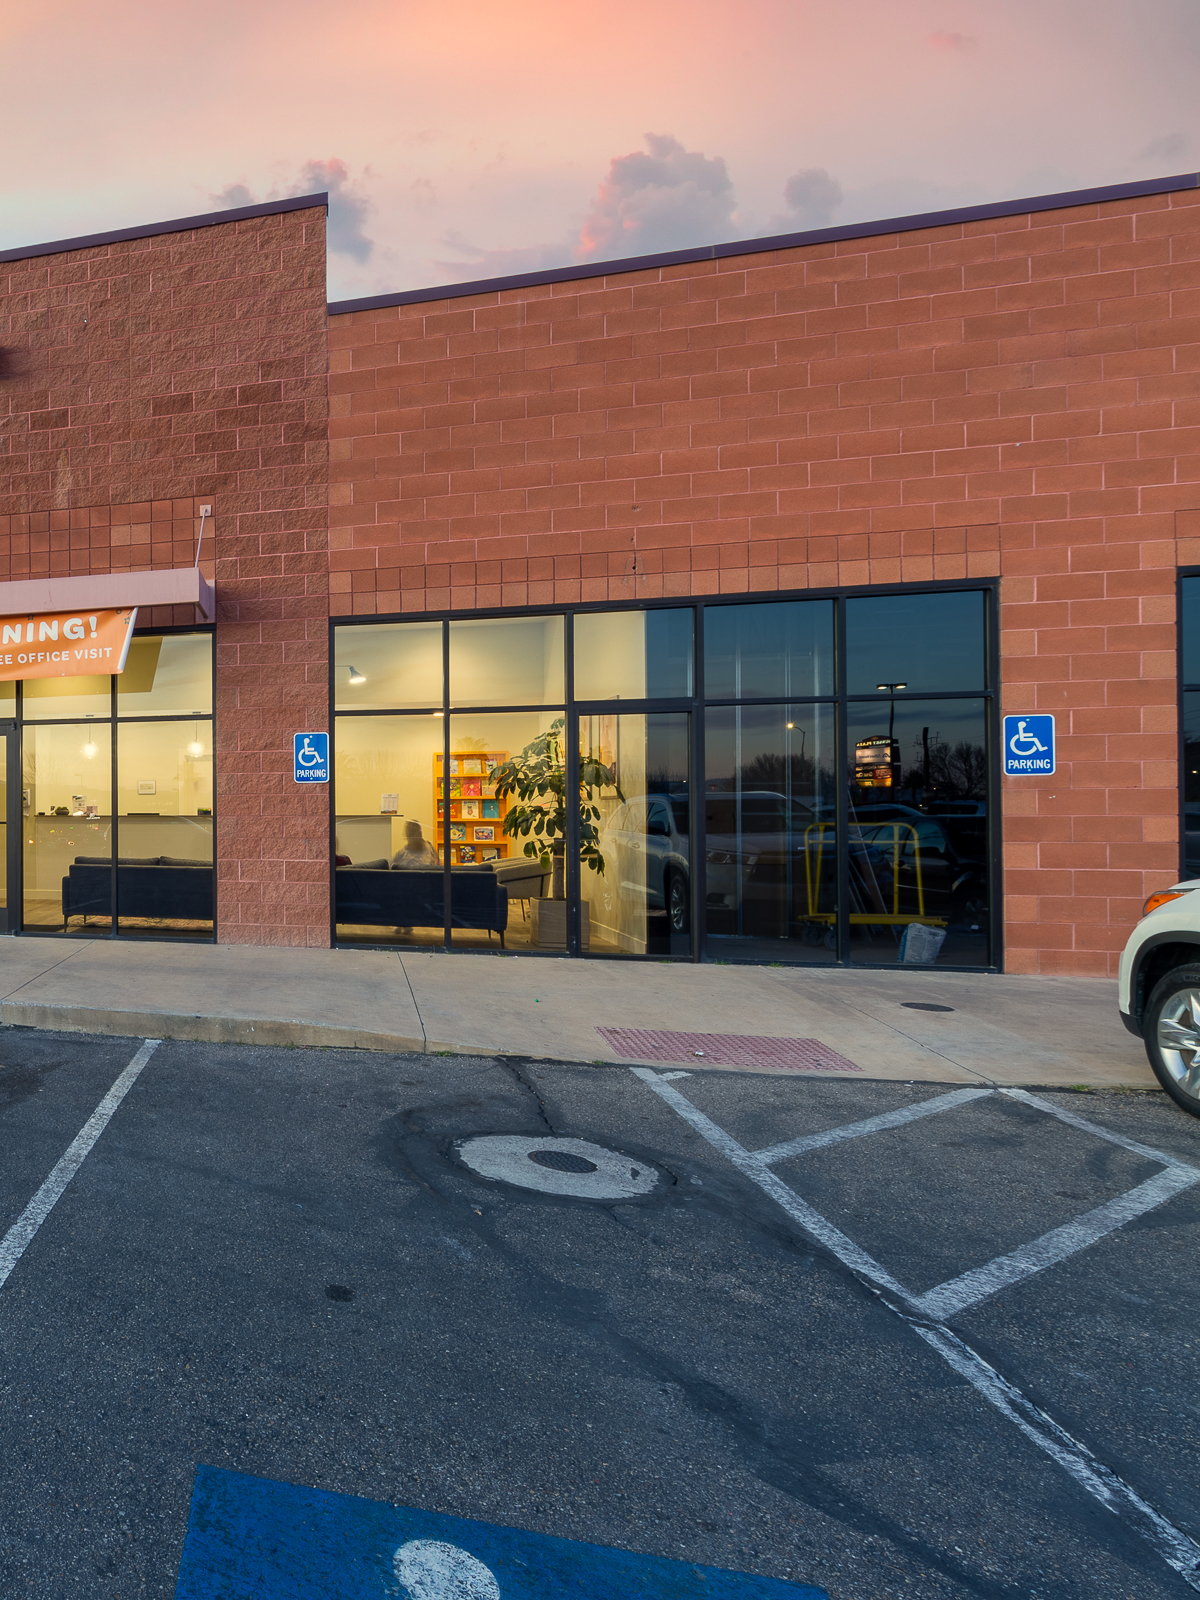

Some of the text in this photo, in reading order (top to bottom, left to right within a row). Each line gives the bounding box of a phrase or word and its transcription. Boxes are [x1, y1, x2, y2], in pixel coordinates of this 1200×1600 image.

[17, 650, 70, 664] OFFICE
[74, 647, 113, 660] VISIT
[1008, 758, 1051, 770] PARKING
[296, 769, 327, 778] PARKING
